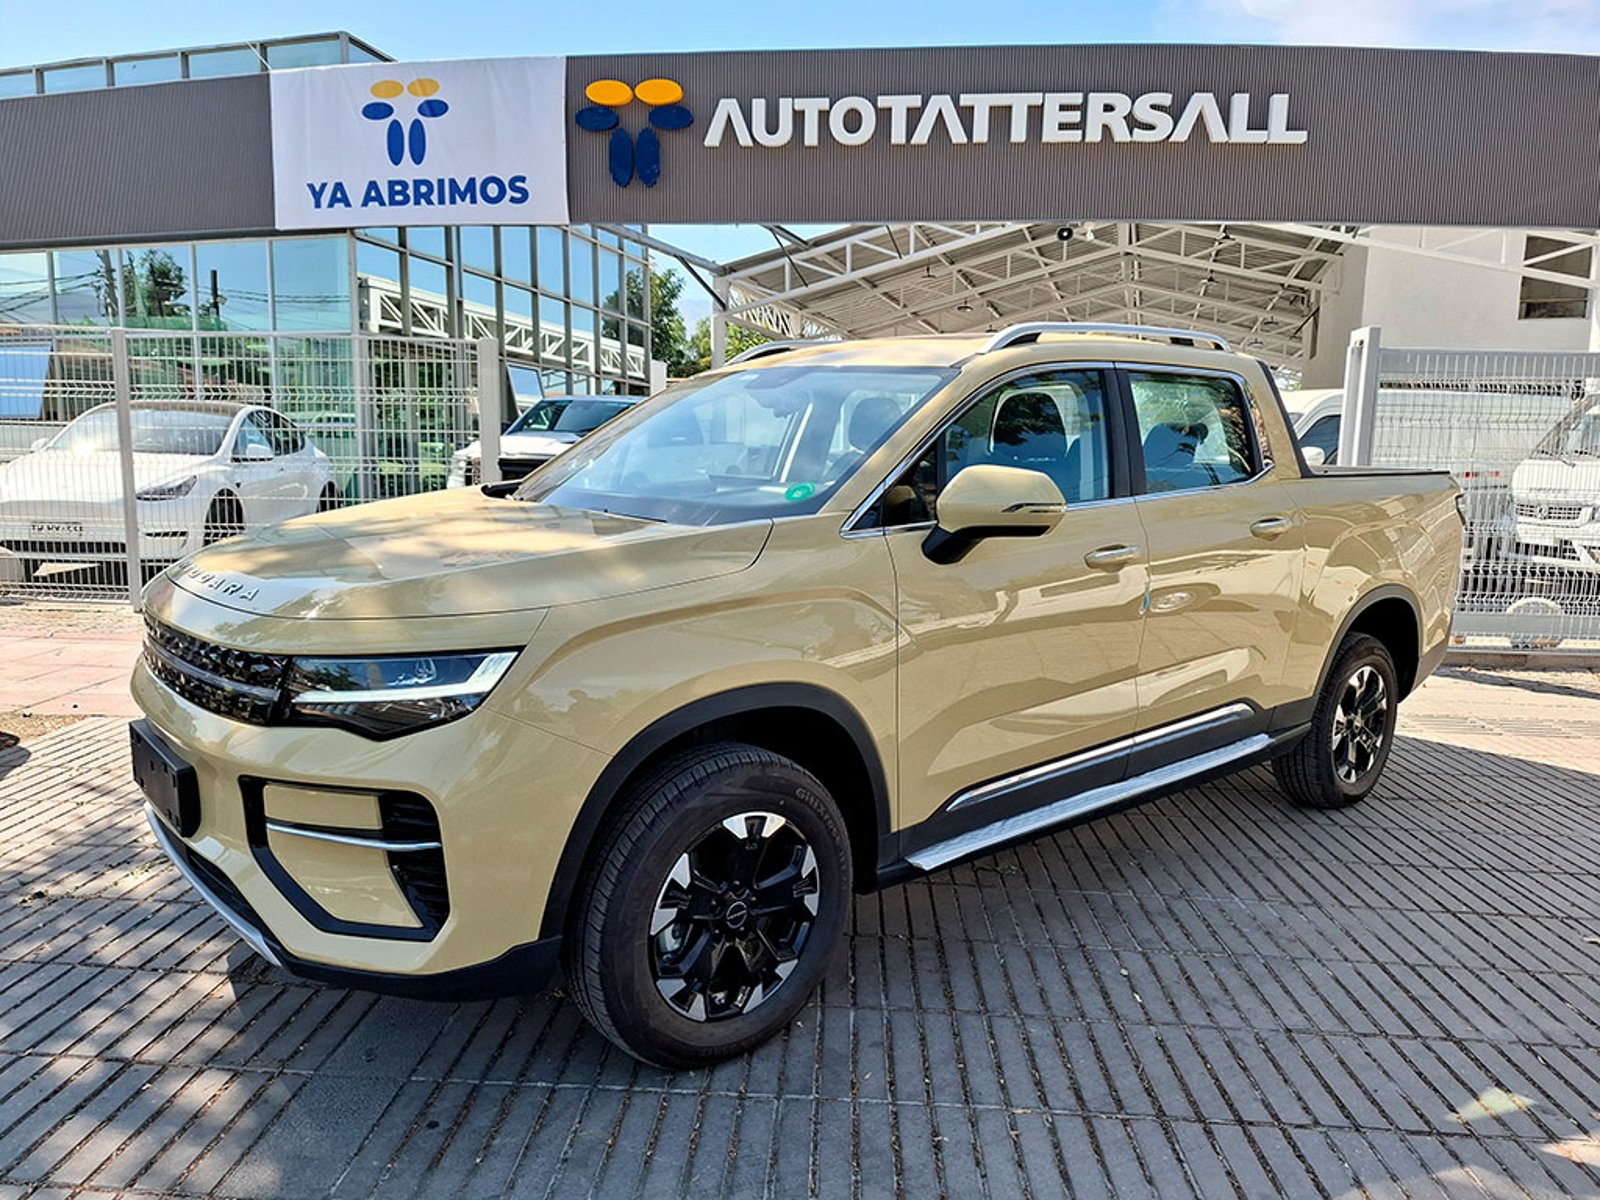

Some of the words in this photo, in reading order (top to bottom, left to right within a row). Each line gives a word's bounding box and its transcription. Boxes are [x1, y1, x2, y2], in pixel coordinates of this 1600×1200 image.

[703, 91, 1308, 147] AUTOTATTERSALL
[307, 182, 352, 209] YA
[360, 176, 529, 208] ABRIMOS
